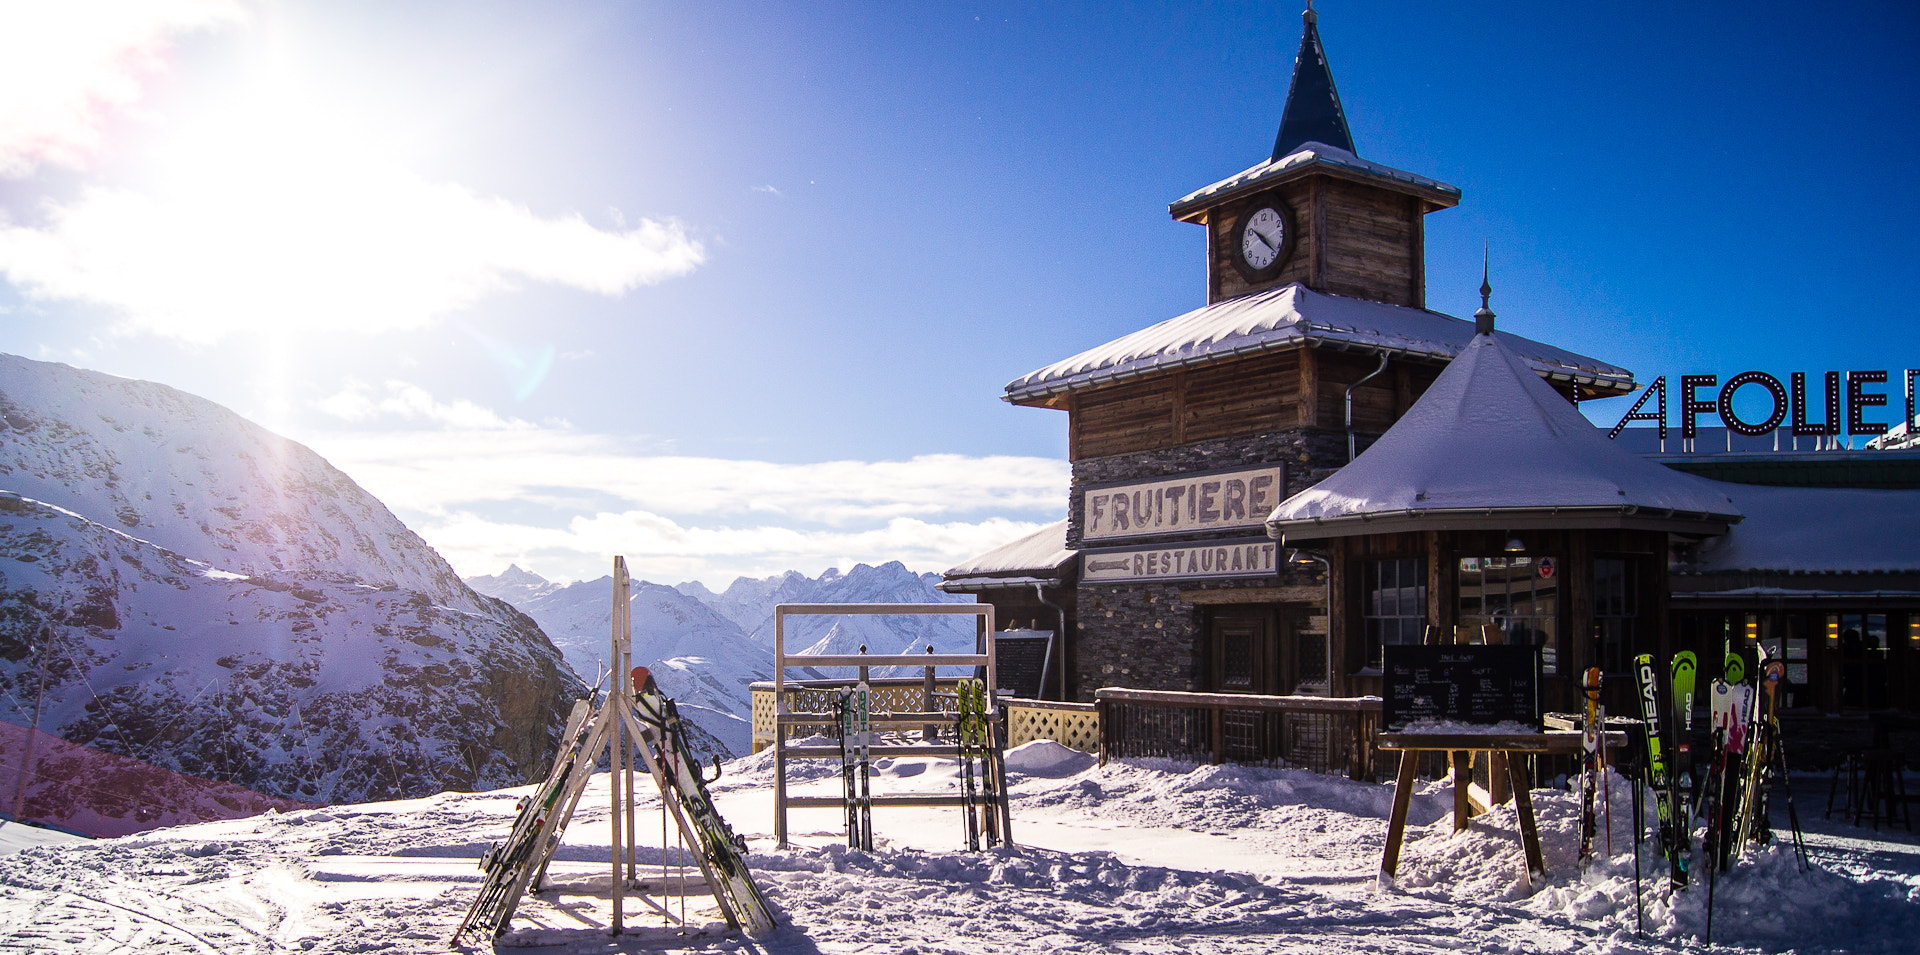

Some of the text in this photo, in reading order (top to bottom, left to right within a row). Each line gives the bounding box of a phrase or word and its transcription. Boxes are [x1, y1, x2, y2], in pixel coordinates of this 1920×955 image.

[1254, 218, 1258, 226] 11
[1261, 213, 1267, 222] 12
[1276, 220, 1281, 228] 2
[1248, 228, 1253, 236] 10
[1245, 240, 1250, 248] 9
[1248, 250, 1252, 259] 8
[1255, 256, 1260, 265] 7
[1271, 251, 1275, 260] 5
[1681, 370, 1888, 439] FOLIE
[1089, 475, 1273, 533] FRUITIERE
[1133, 544, 1275, 576] RESTAURANT
[960, 681, 971, 733] FISCHER
[974, 681, 985, 732] FISCHER
[1640, 665, 1659, 736] HEAD
[1741, 688, 1751, 723] HEAD
[859, 690, 867, 733] HEAD
